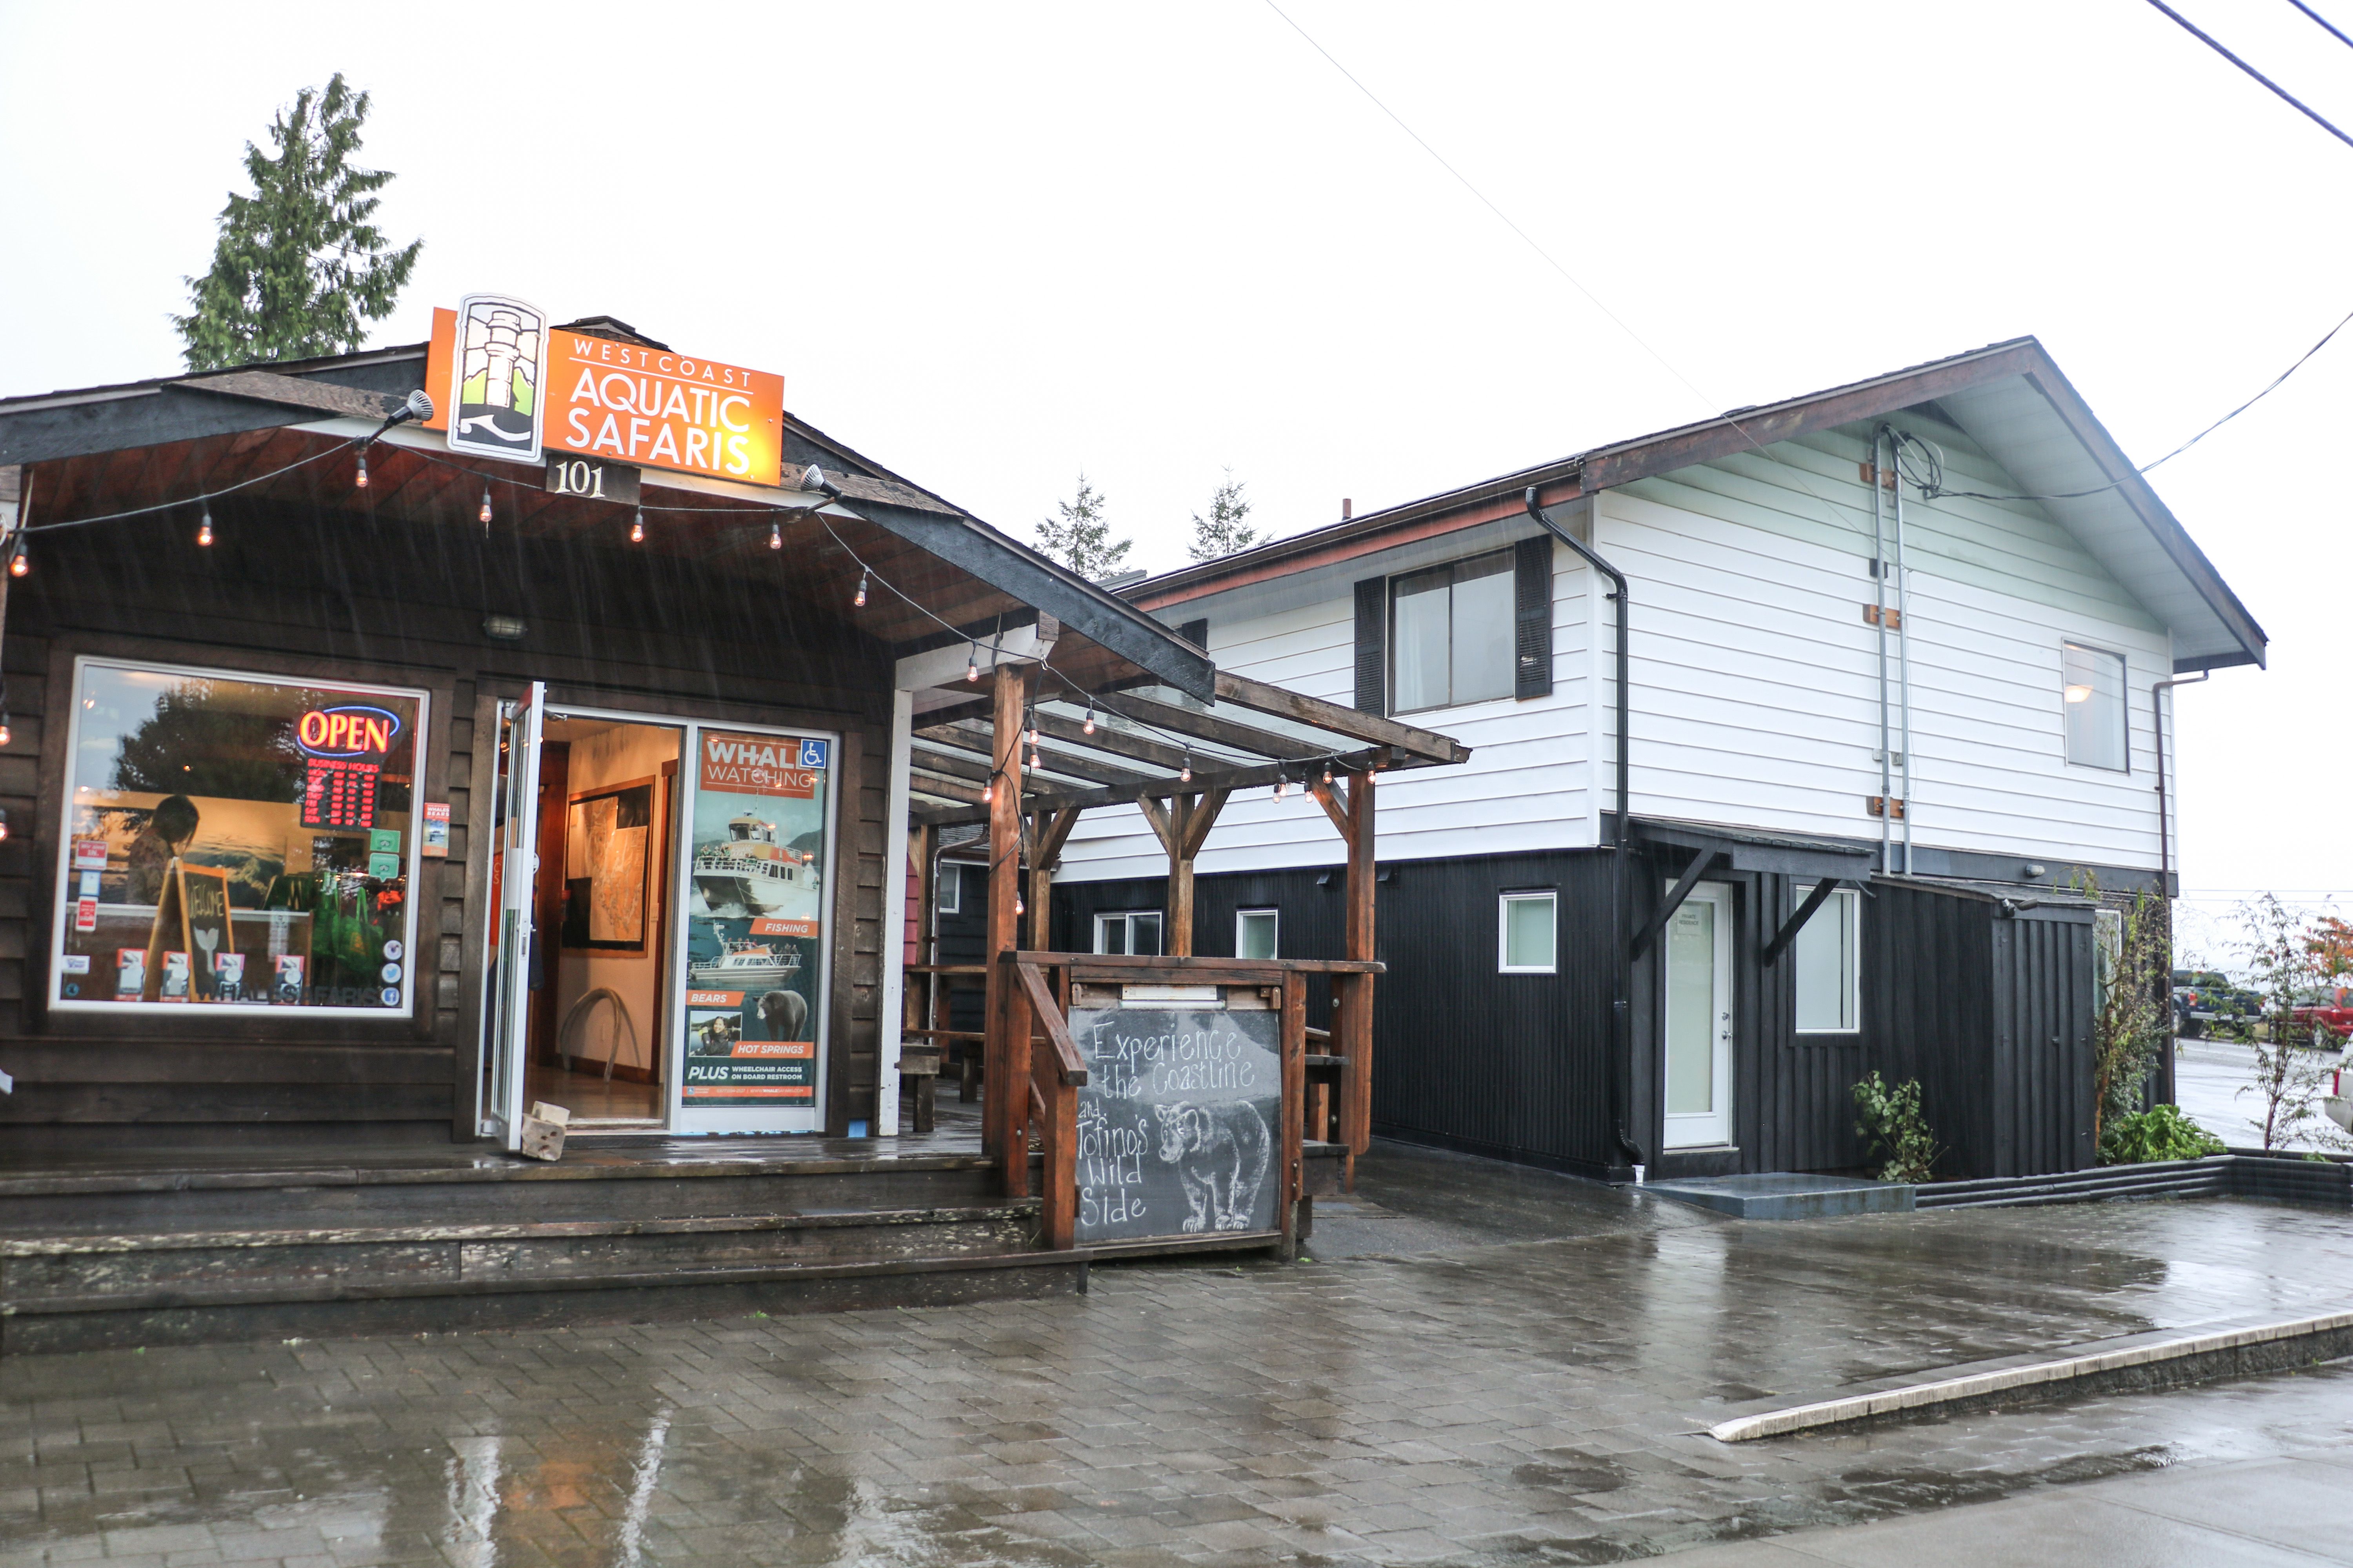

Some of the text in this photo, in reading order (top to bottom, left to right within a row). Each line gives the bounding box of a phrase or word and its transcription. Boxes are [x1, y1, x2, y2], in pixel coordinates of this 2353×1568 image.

[574, 338, 750, 387] WESTCOAST
[569, 368, 750, 432] AQUATIC
[565, 408, 750, 474] SAFARIS
[555, 460, 605, 498] 101
[300, 711, 389, 753] OPEN
[707, 765, 811, 788] WATCHING
[765, 923, 809, 933] FISHING
[691, 994, 727, 1003] BEARS
[737, 1045, 804, 1054] HOT SPRINGS
[1093, 1021, 1240, 1074] Experience
[688, 1066, 729, 1080] PLUS
[1102, 1058, 1255, 1099] the Coastline
[1078, 1097, 1100, 1118] and
[1087, 1153, 1142, 1186] Wild
[1081, 1187, 1146, 1226] Side
